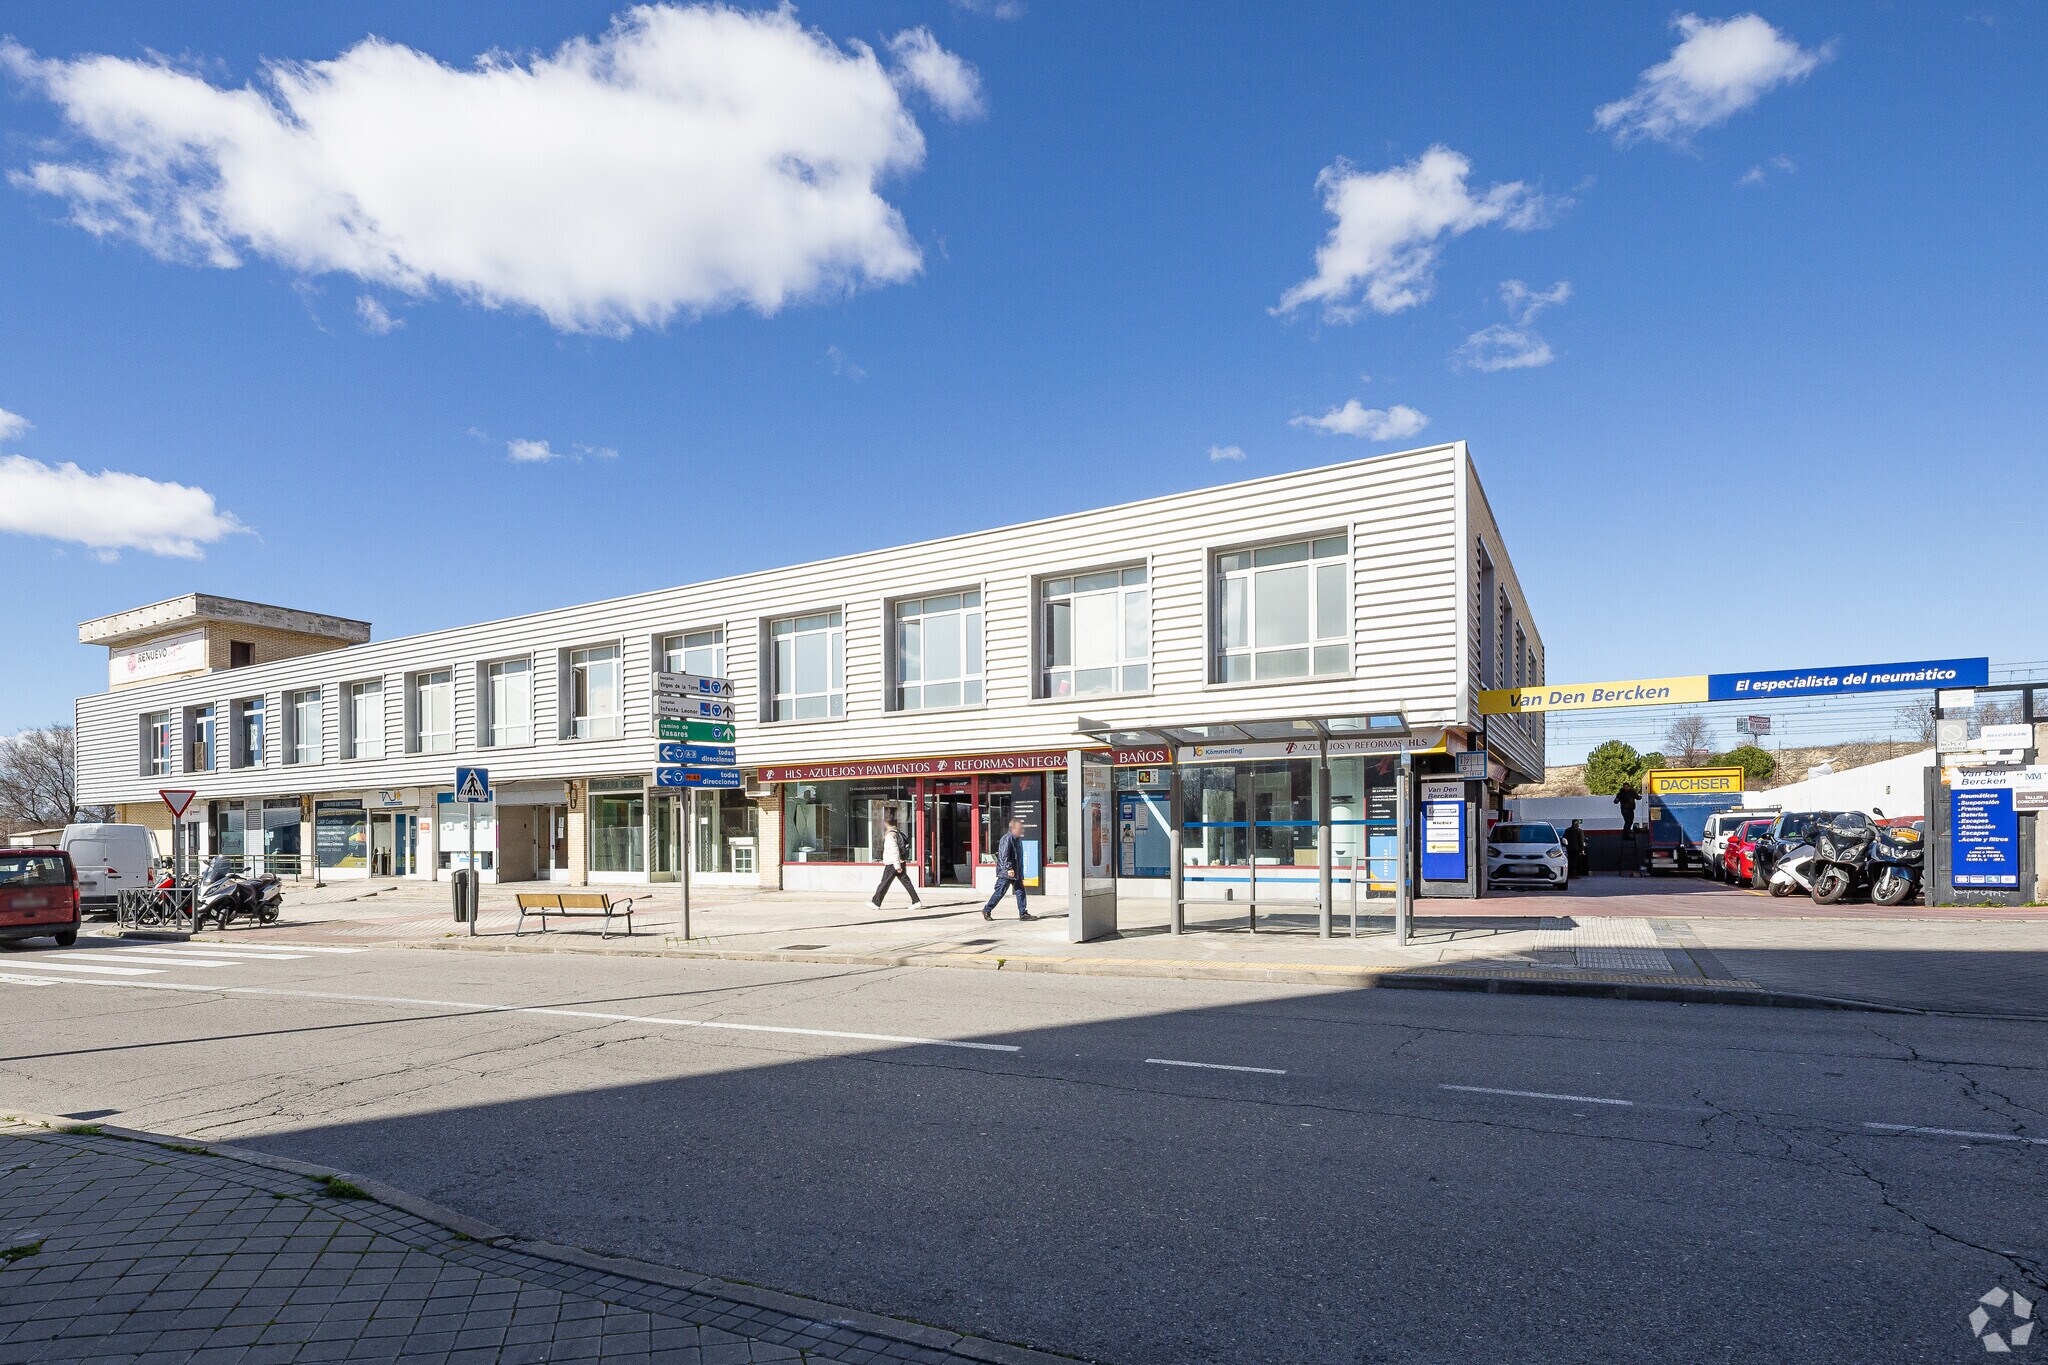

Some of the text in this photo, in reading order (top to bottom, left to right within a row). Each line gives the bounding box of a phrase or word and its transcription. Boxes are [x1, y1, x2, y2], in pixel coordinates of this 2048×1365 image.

[138, 648, 167, 662] RENUEVO
[1736, 668, 1956, 692] El especialista del neumático
[1510, 685, 1670, 708] Van Den Bercken
[1206, 748, 1242, 756] Kömmerling
[1302, 742, 1347, 752] AZUJOS
[1355, 740, 1402, 749] REFORMAS
[1408, 738, 1428, 747] HLS
[954, 754, 1068, 770] REFORMAS INTEGRA
[1120, 750, 1164, 763] BAÑOS
[785, 769, 802, 779] HLS
[809, 766, 856, 778] AZULEJOS
[857, 766, 864, 774] Y
[866, 762, 930, 774] PAVIMENTOS
[1660, 778, 1729, 790] DACHSER
